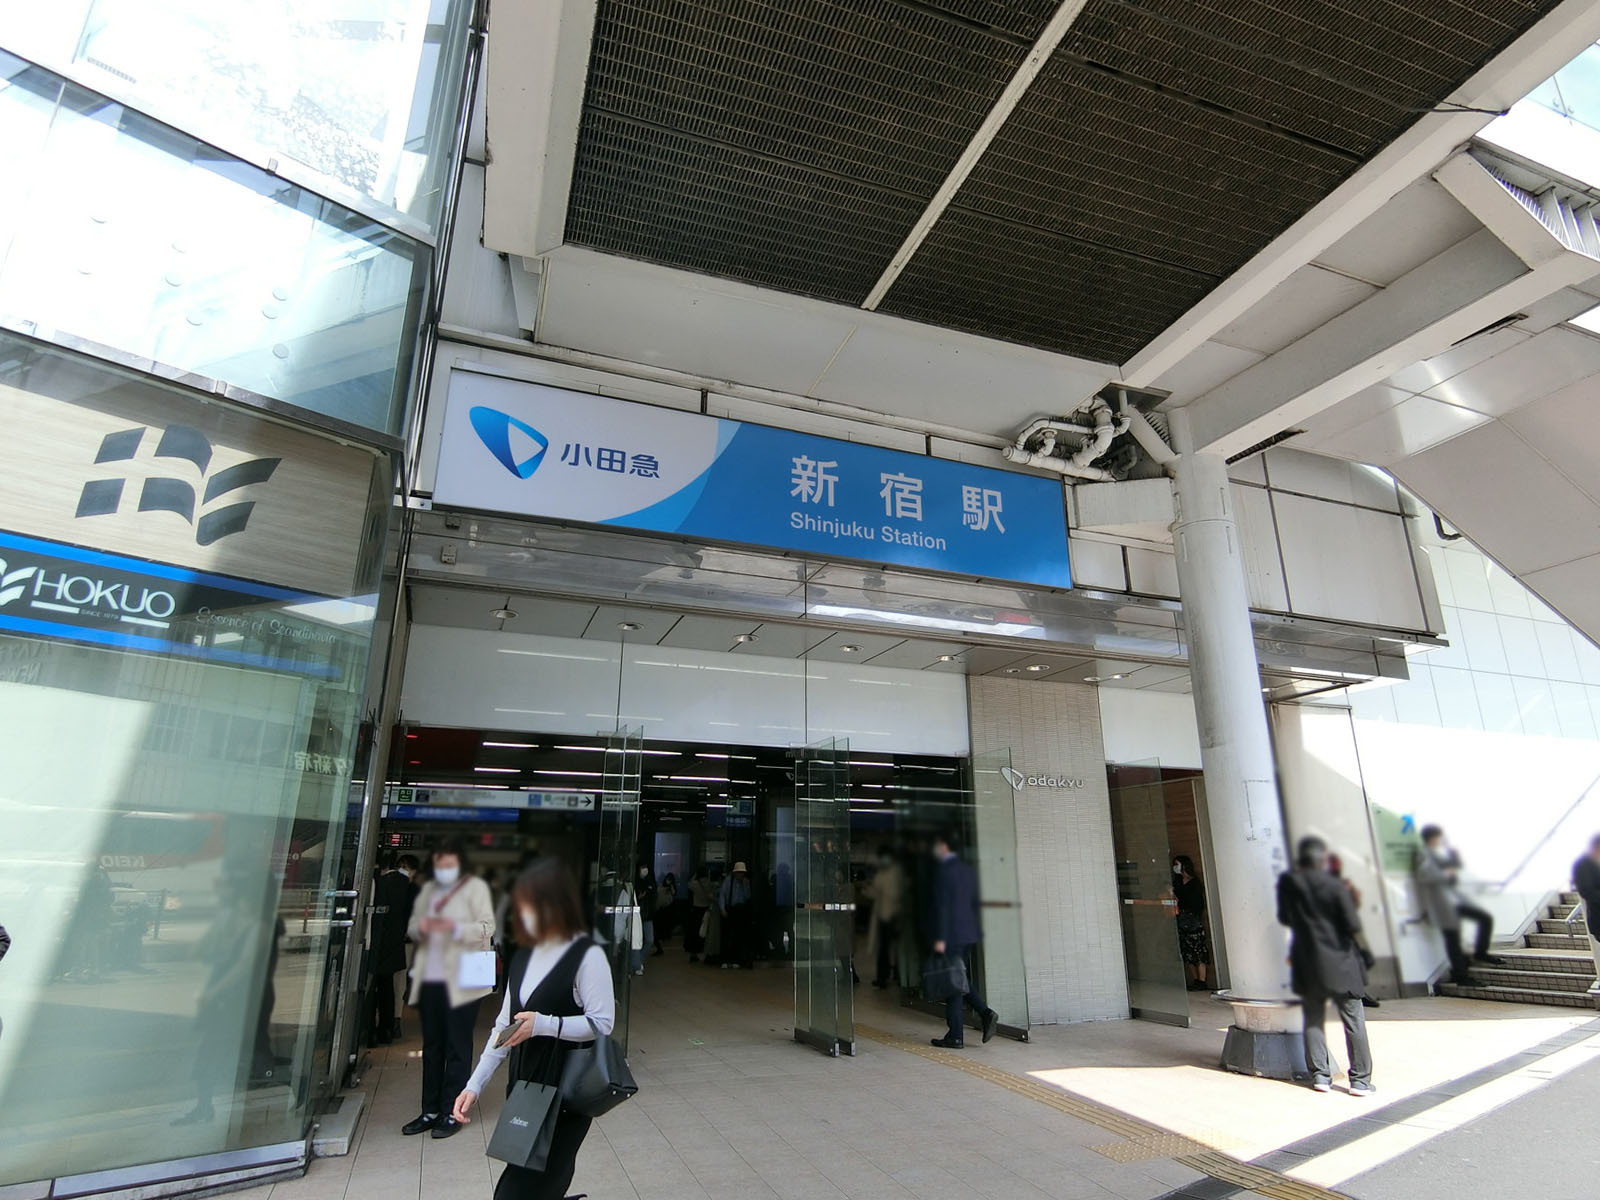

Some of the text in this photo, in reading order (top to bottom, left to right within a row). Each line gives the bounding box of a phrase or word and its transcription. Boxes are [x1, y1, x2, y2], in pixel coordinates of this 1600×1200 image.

[560, 443, 660, 479] 小田急
[790, 454, 1006, 535] 新宿駅
[790, 511, 947, 551] Shinjuku Station
[33, 569, 176, 618] HOKUO
[195, 606, 249, 629] Essence
[251, 617, 265, 636] of
[1027, 775, 1084, 788] odakyu
